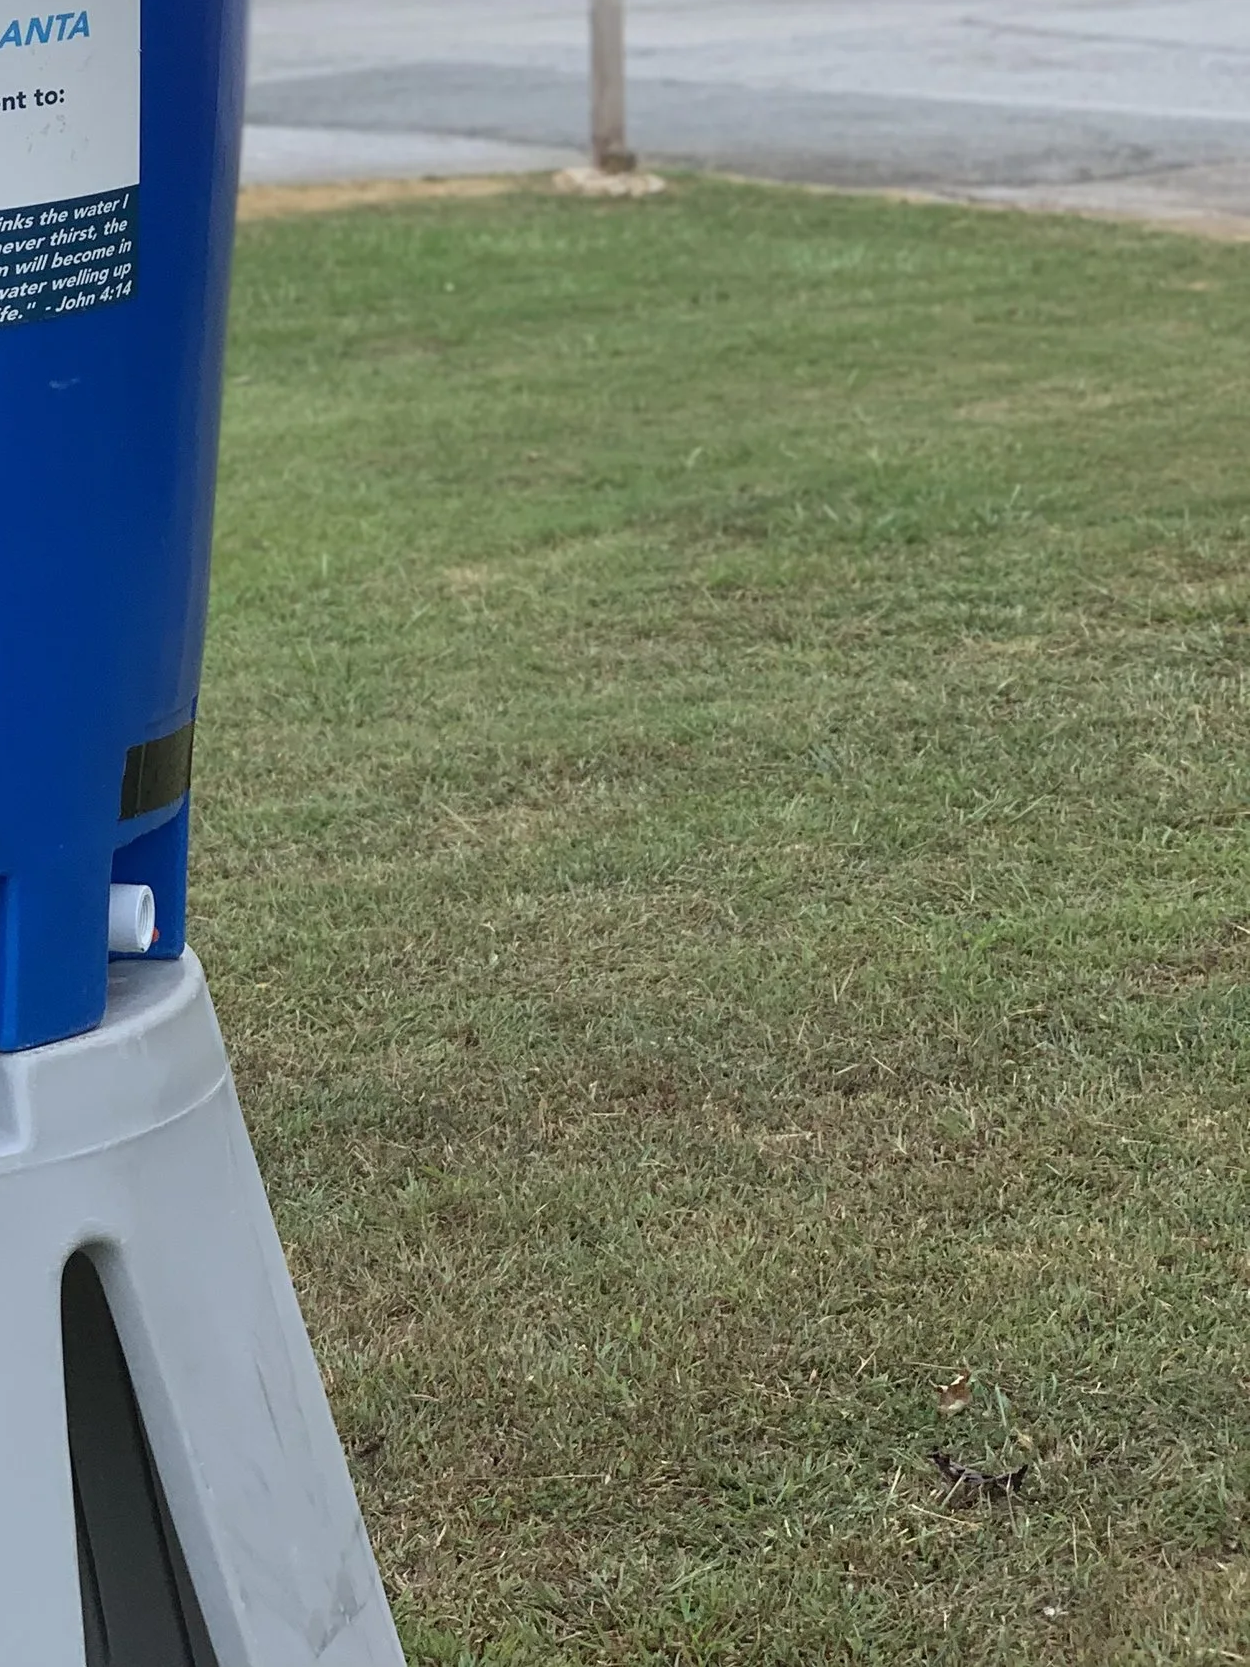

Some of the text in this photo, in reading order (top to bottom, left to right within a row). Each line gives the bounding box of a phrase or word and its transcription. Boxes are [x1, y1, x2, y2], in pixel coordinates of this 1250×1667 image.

[33, 85, 66, 108] to:
[40, 208, 68, 226] the
[73, 200, 119, 220] water
[50, 224, 98, 247] thirst,
[103, 219, 127, 236] the
[15, 257, 46, 275] will
[51, 245, 114, 270] become
[118, 239, 132, 254] in
[51, 268, 110, 294] welling
[113, 262, 132, 282] up
[55, 293, 96, 313] John
[100, 282, 132, 302] 4:14
